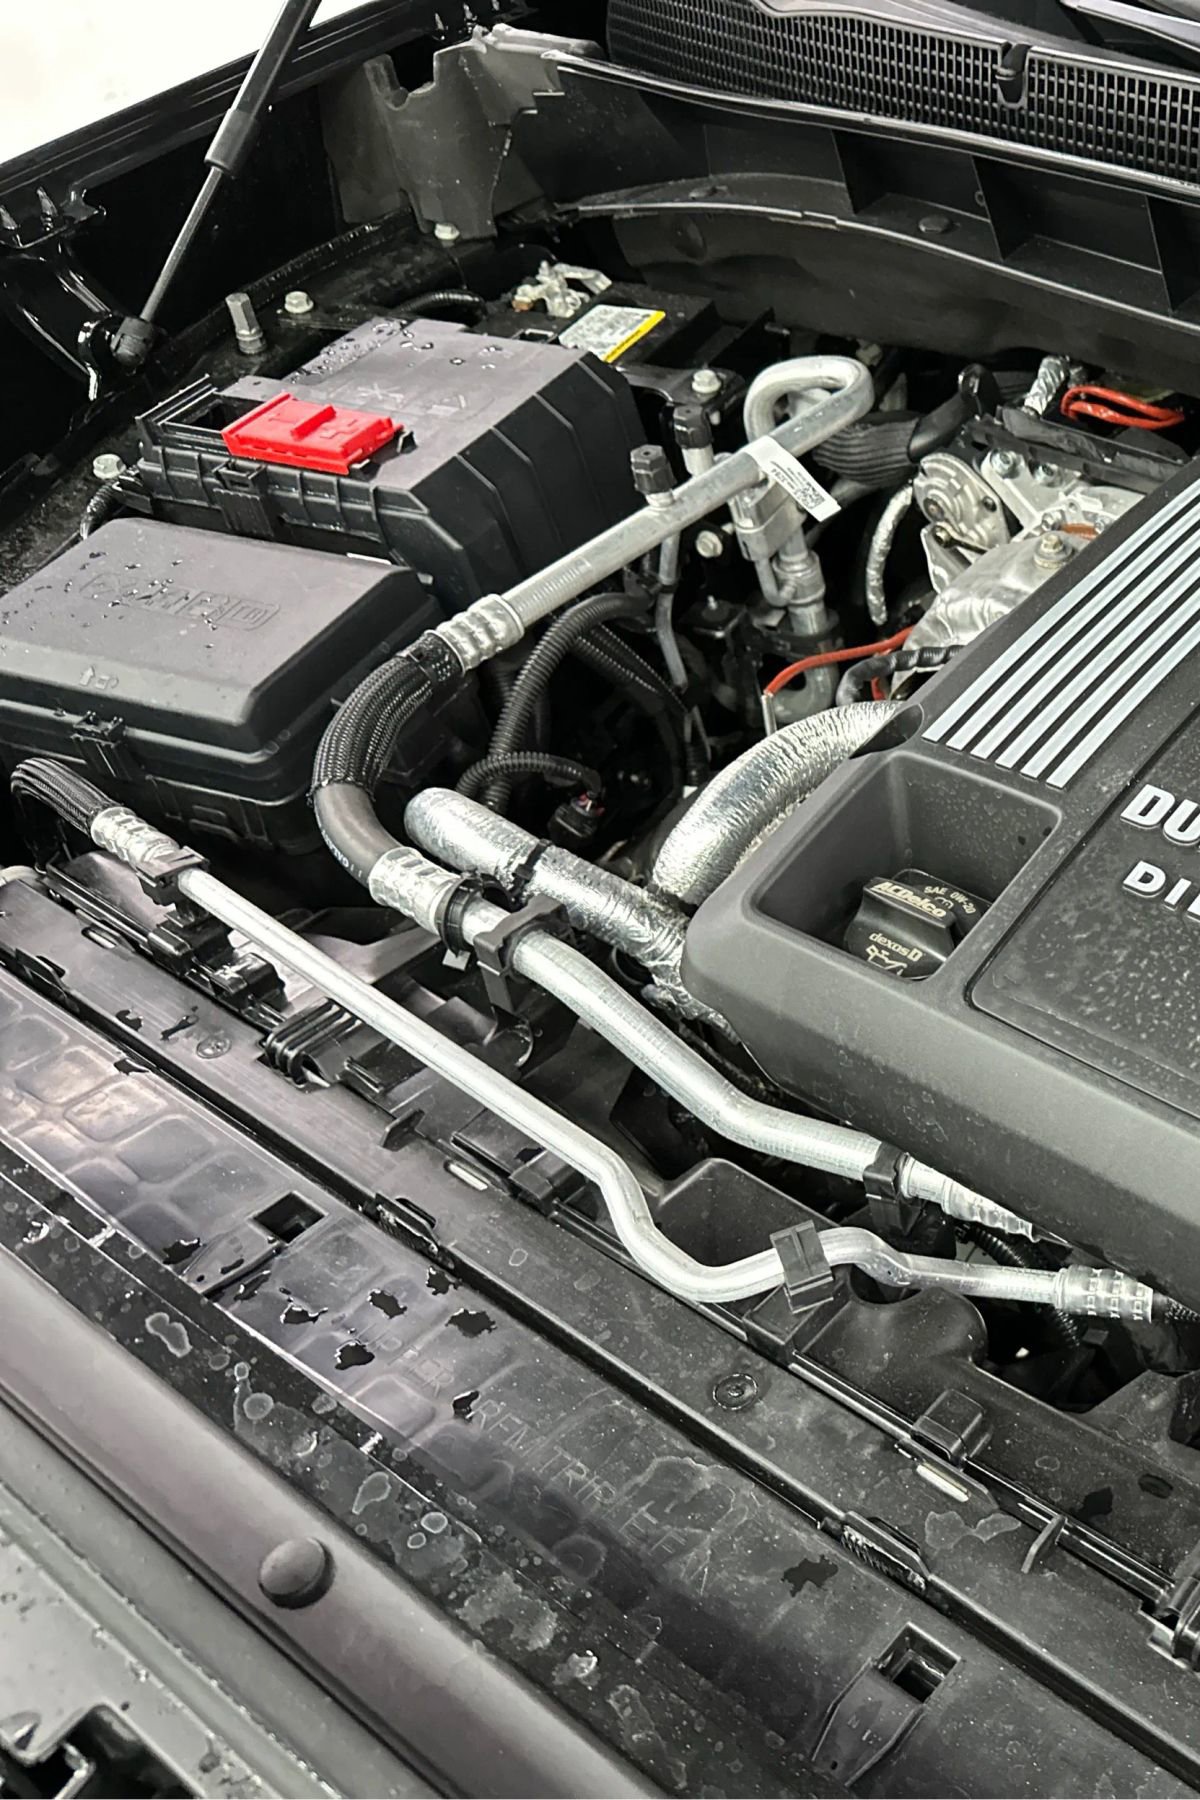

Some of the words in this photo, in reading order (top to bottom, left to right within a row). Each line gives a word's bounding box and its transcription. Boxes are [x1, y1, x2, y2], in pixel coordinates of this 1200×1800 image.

[872, 881, 947, 918] ACDelco
[924, 885, 949, 896] SAE
[950, 892, 977, 915] 0W-20
